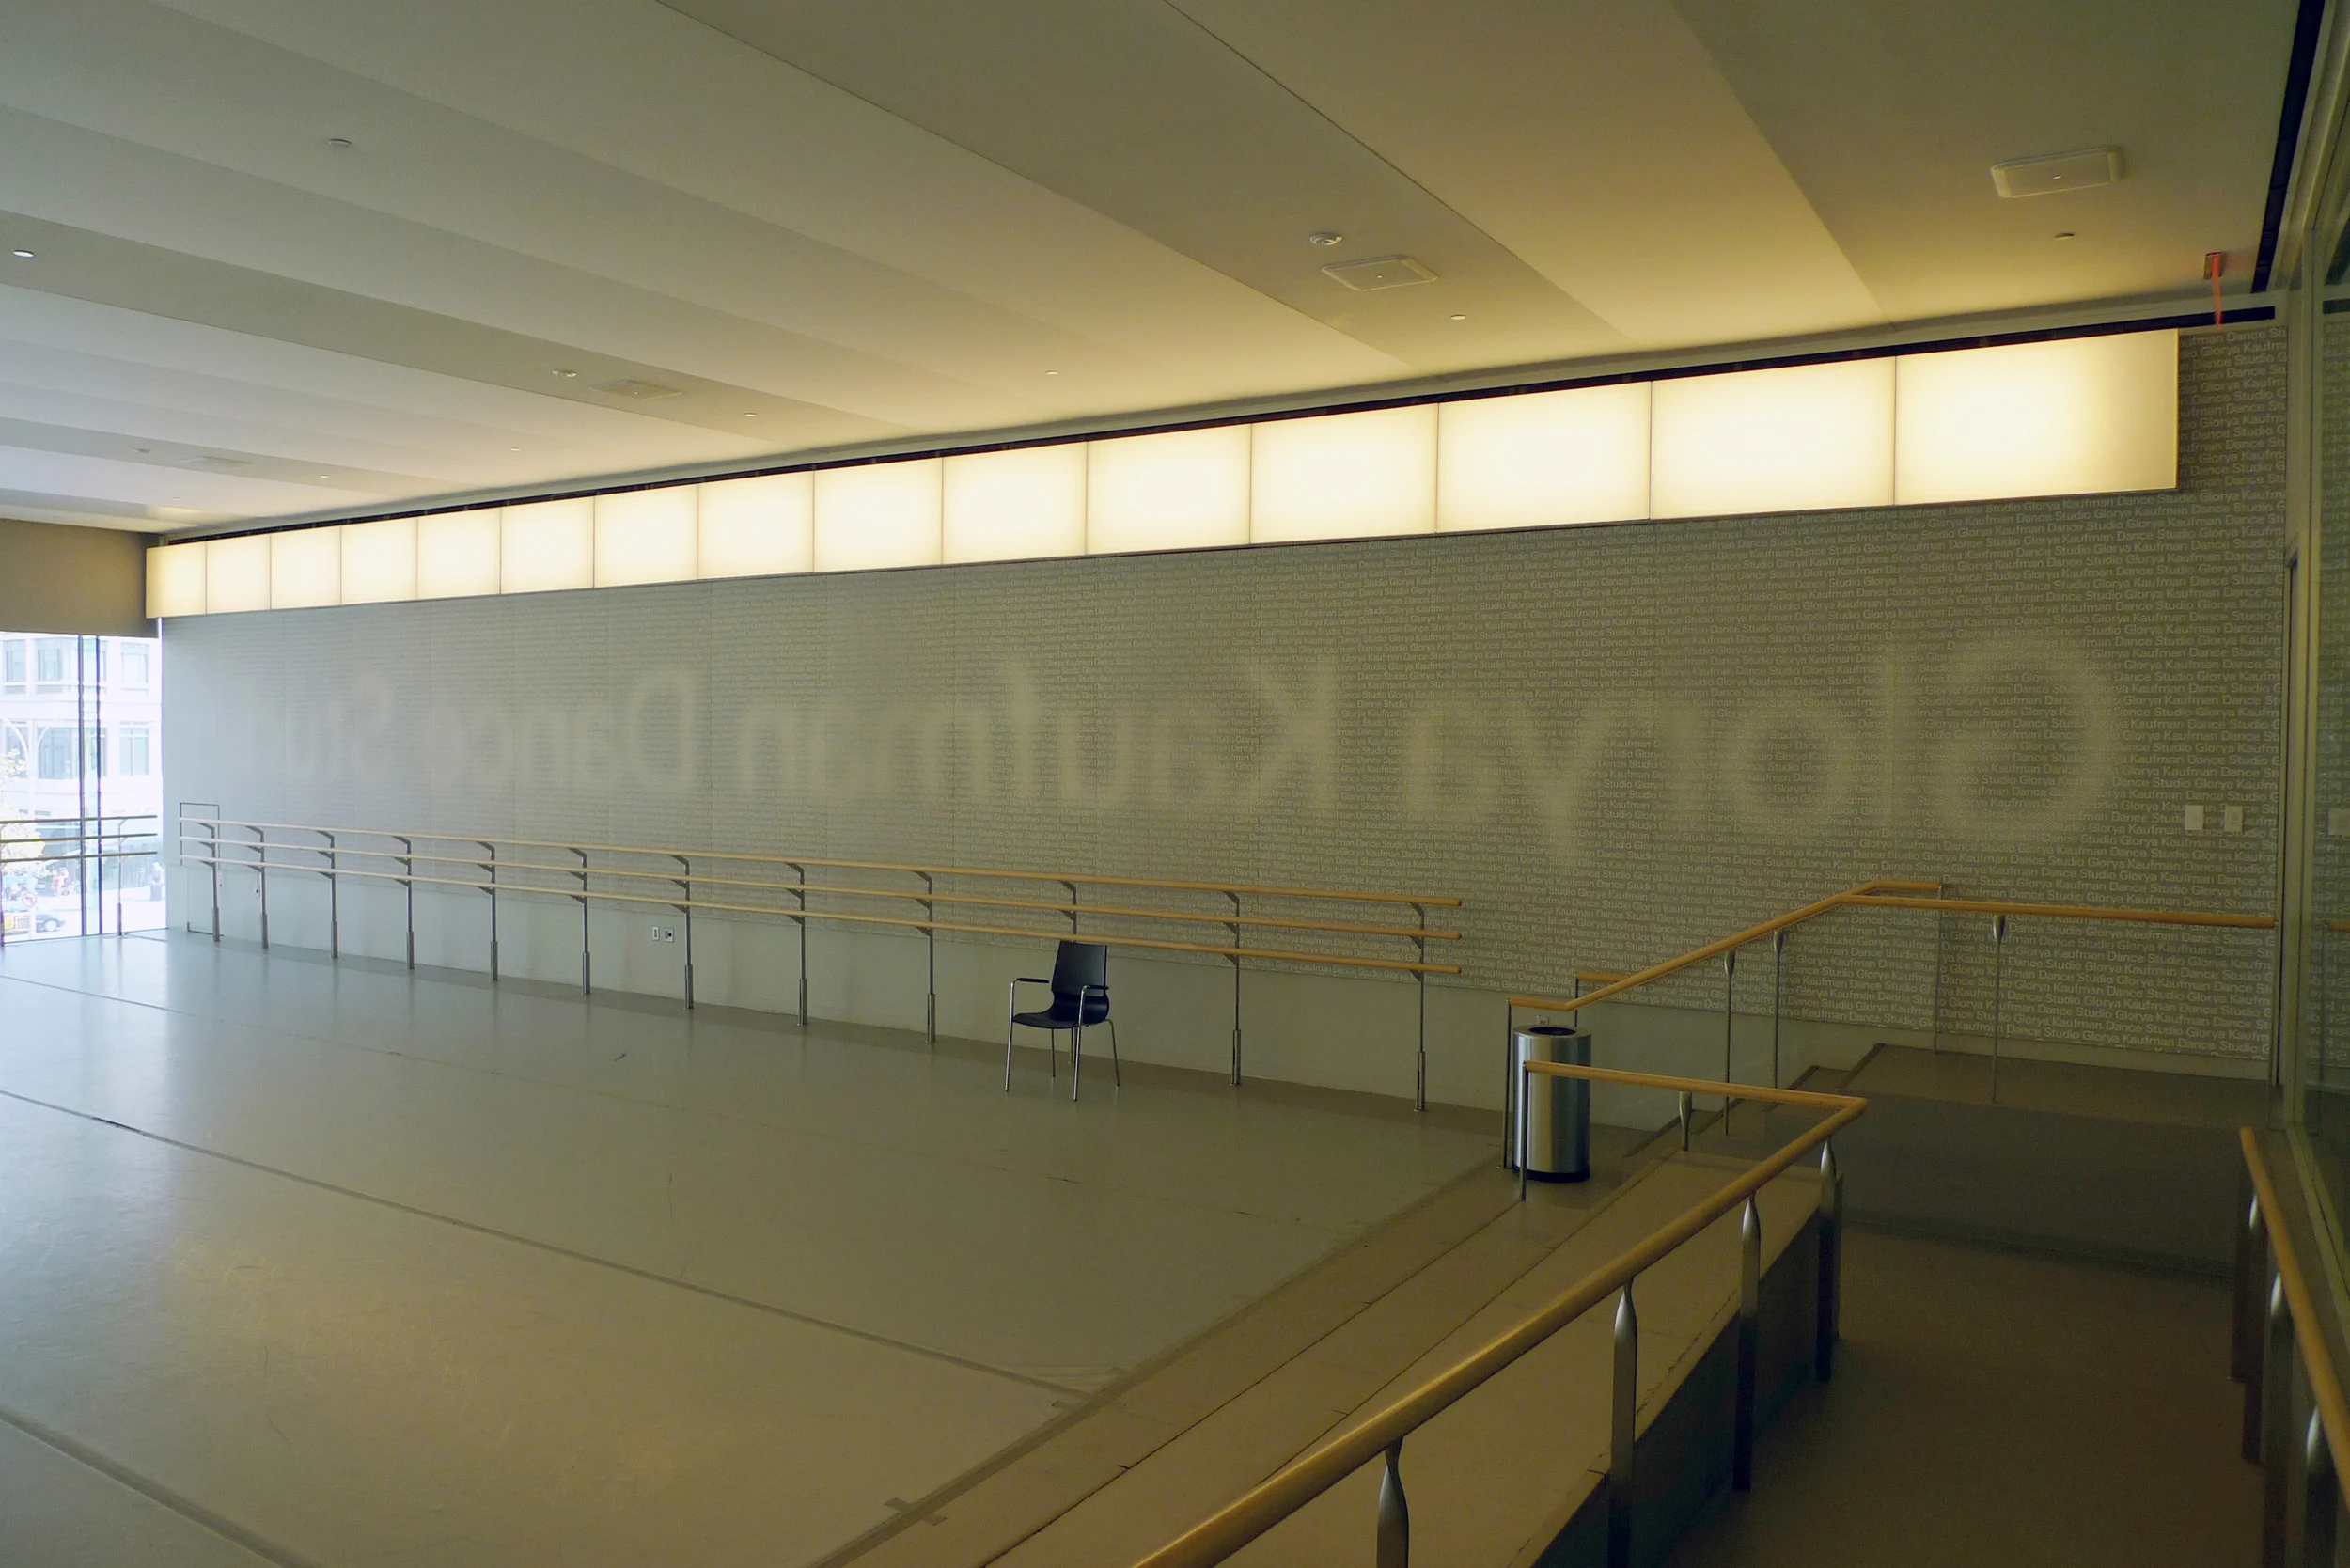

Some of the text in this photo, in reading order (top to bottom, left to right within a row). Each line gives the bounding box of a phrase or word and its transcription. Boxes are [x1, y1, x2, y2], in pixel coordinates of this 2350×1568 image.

[2226, 364, 2266, 377] Dance
[2232, 388, 2274, 400] Studio
[2232, 424, 2273, 436] Studio
[2232, 461, 2272, 472] Studio
[1744, 502, 2230, 537] Studio Glorya Kaufman Dance Studio Glorya Kaufman Dance Studio Glorya Kaufman Dance
[1768, 569, 1800, 578] Studio
[1802, 567, 1834, 579] Glorya
[1837, 565, 1882, 574] Kaufman
[1884, 563, 1918, 573] Dance
[1919, 562, 1954, 572] Studio
[1956, 560, 1992, 572] Glorya
[1994, 557, 2044, 569] Kaufman
[2046, 556, 2083, 566] Dance
[2085, 554, 2123, 565] Studio
[2124, 553, 2164, 565] Glorya
[2167, 551, 2221, 562] Kaufman
[2223, 549, 2264, 560] Dance
[1749, 599, 2236, 621] Kaufman Dance Studio Glorya Kaufman Dance Studio Glorya Kaufman Dance Studio Glorya
[1742, 653, 1853, 666] Studio Glorya Kaufman
[2091, 646, 2270, 660] Glorya Kaufman Dance Studio
[1918, 695, 2080, 706] Studio Glorya Kaufman Dance
[2122, 694, 2262, 706] Glorya Kaufman Dance
[1749, 741, 1792, 749] Kaufman
[2112, 742, 2234, 754] Dance Studio Glorya
[2129, 789, 2266, 800] Kaufman Dance Studio
[2079, 833, 2258, 849] Studio Glorya Kaufman Dance
[1745, 867, 1856, 879] Kaufman Dance Studio
[1942, 873, 2231, 898] Dance Studio Glorya Kaufman Dance Studio Glorya
[2008, 922, 2263, 945] Dance Studio Glorya Kaufman Dance Studio
[1796, 954, 1911, 969] Glorya Kaufman Dance
[2037, 969, 2252, 992] Dance Studio Glorya Kaufman Dance
[1787, 996, 1888, 1013] Dance Studio Glorya
[2013, 1012, 2225, 1041] Glorya Kaufman Dance Studio Glorya
